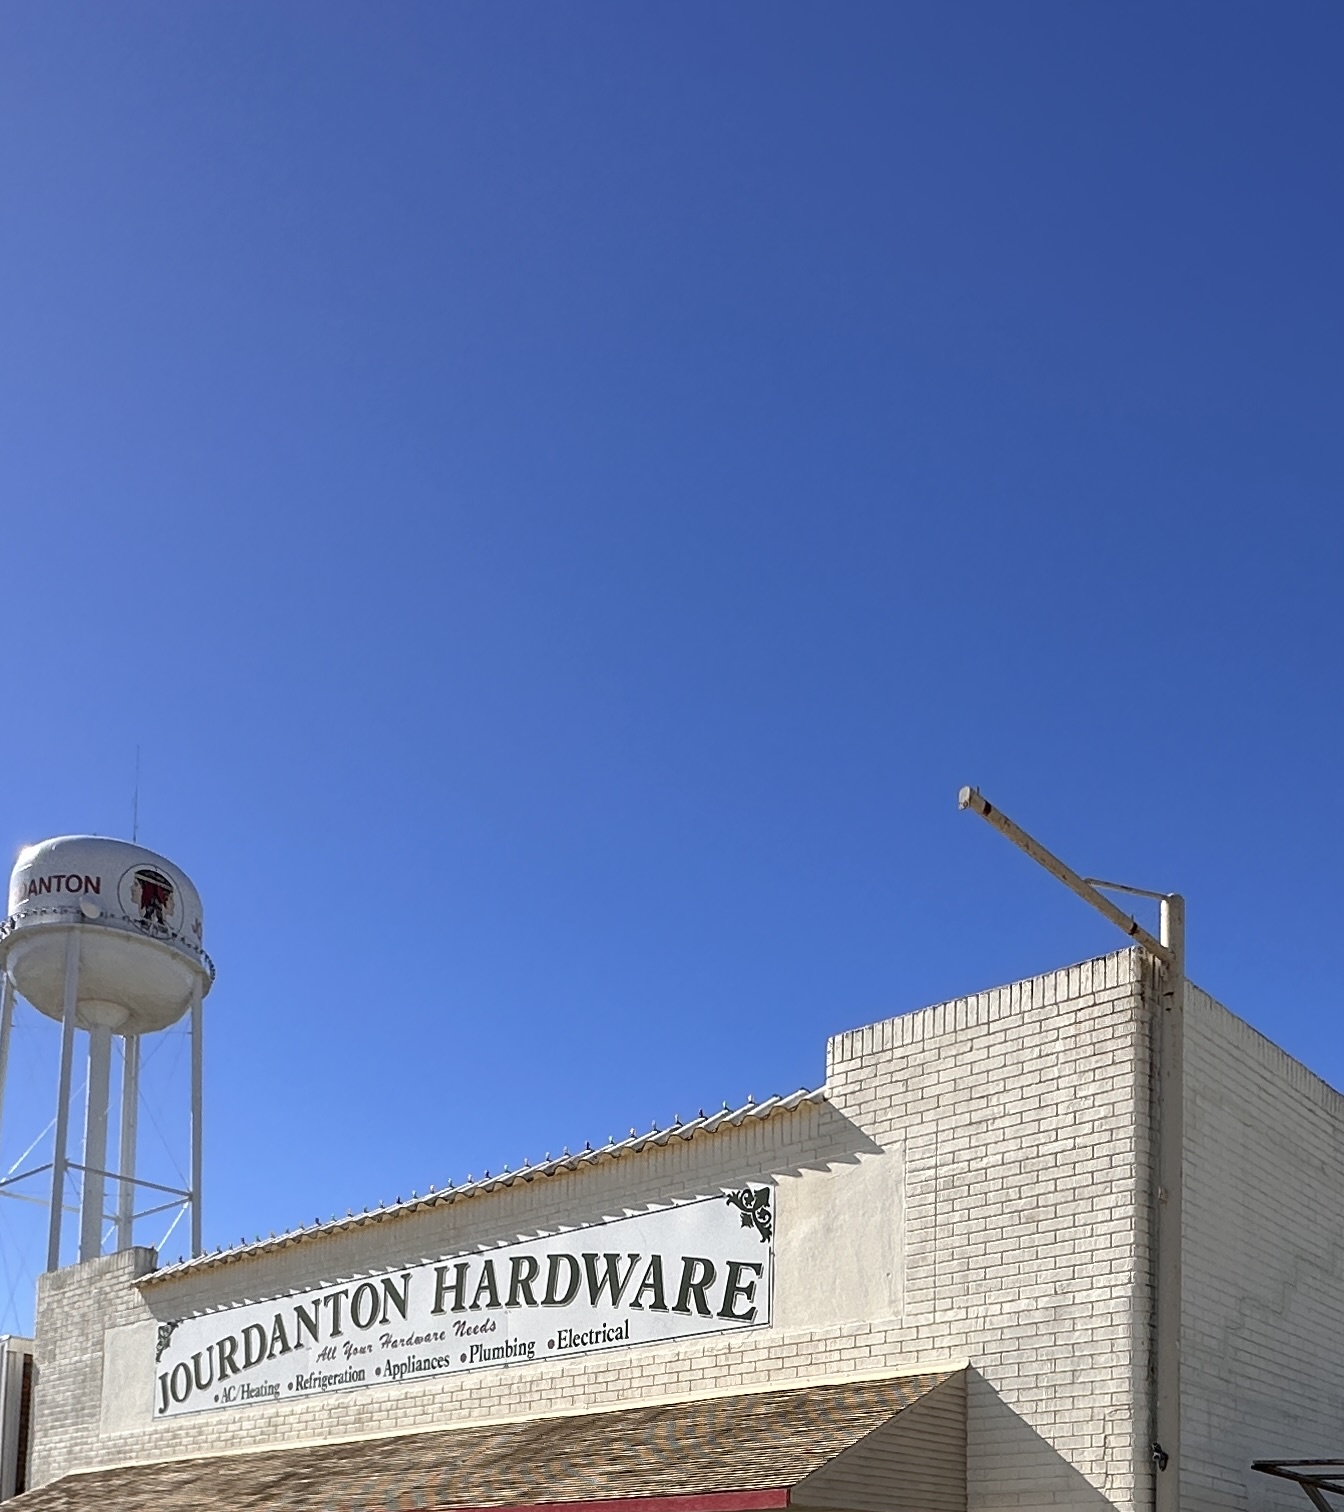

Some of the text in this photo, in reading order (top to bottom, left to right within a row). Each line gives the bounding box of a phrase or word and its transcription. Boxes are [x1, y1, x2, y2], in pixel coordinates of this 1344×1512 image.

[158, 1253, 764, 1415] JOURDANTON HARDWARE
[221, 1319, 630, 1404] AC/Heating Refrigeration Appliances Plumbing Electrical
[316, 1318, 497, 1363] All Your Hardware Needs
